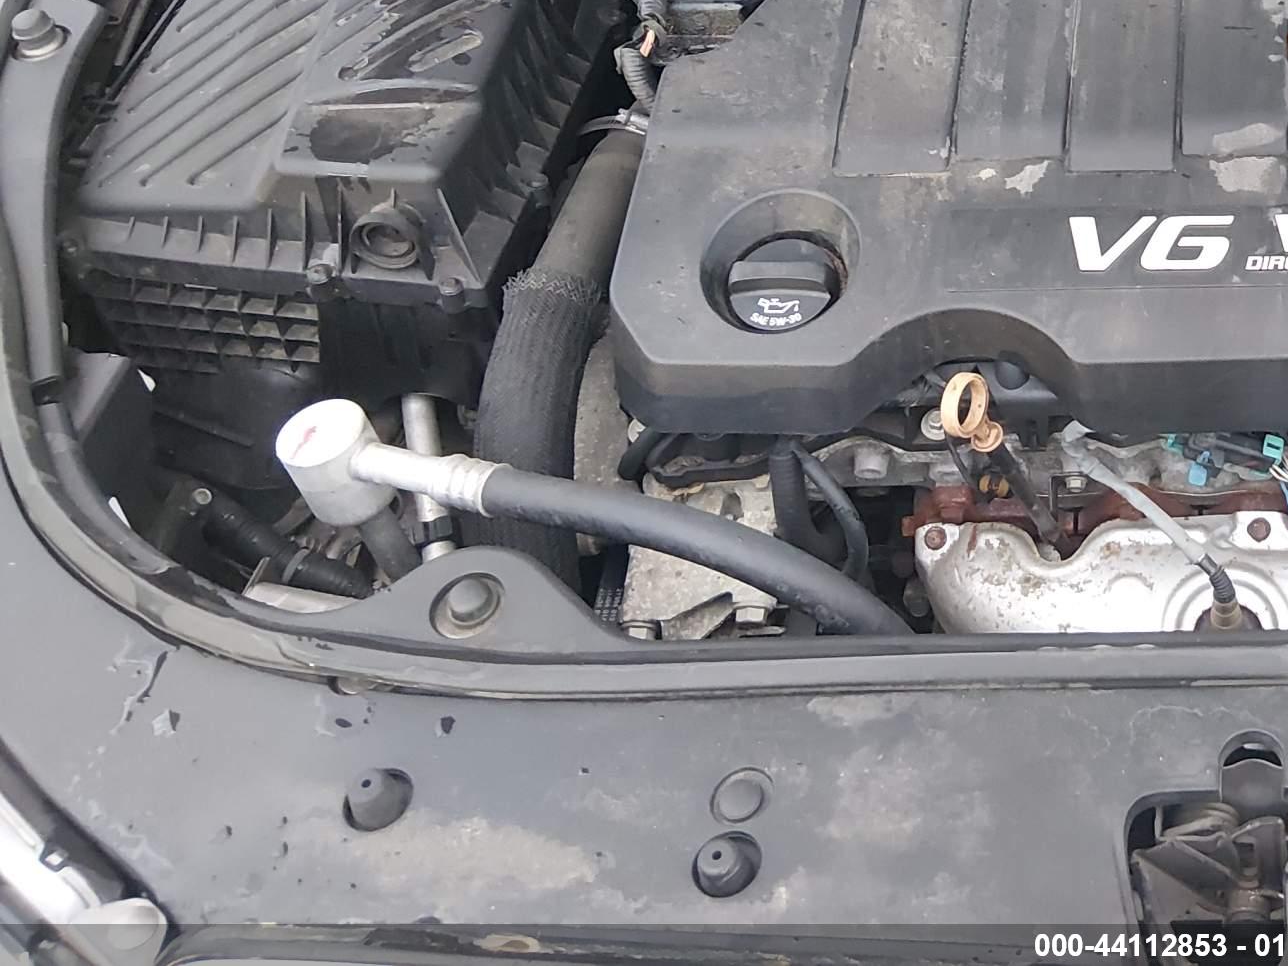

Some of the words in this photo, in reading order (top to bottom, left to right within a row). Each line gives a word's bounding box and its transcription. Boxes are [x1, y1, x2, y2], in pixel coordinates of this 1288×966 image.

[1068, 216, 1234, 271] V6
[750, 312, 770, 326] SAE
[769, 313, 802, 327] 5W-30
